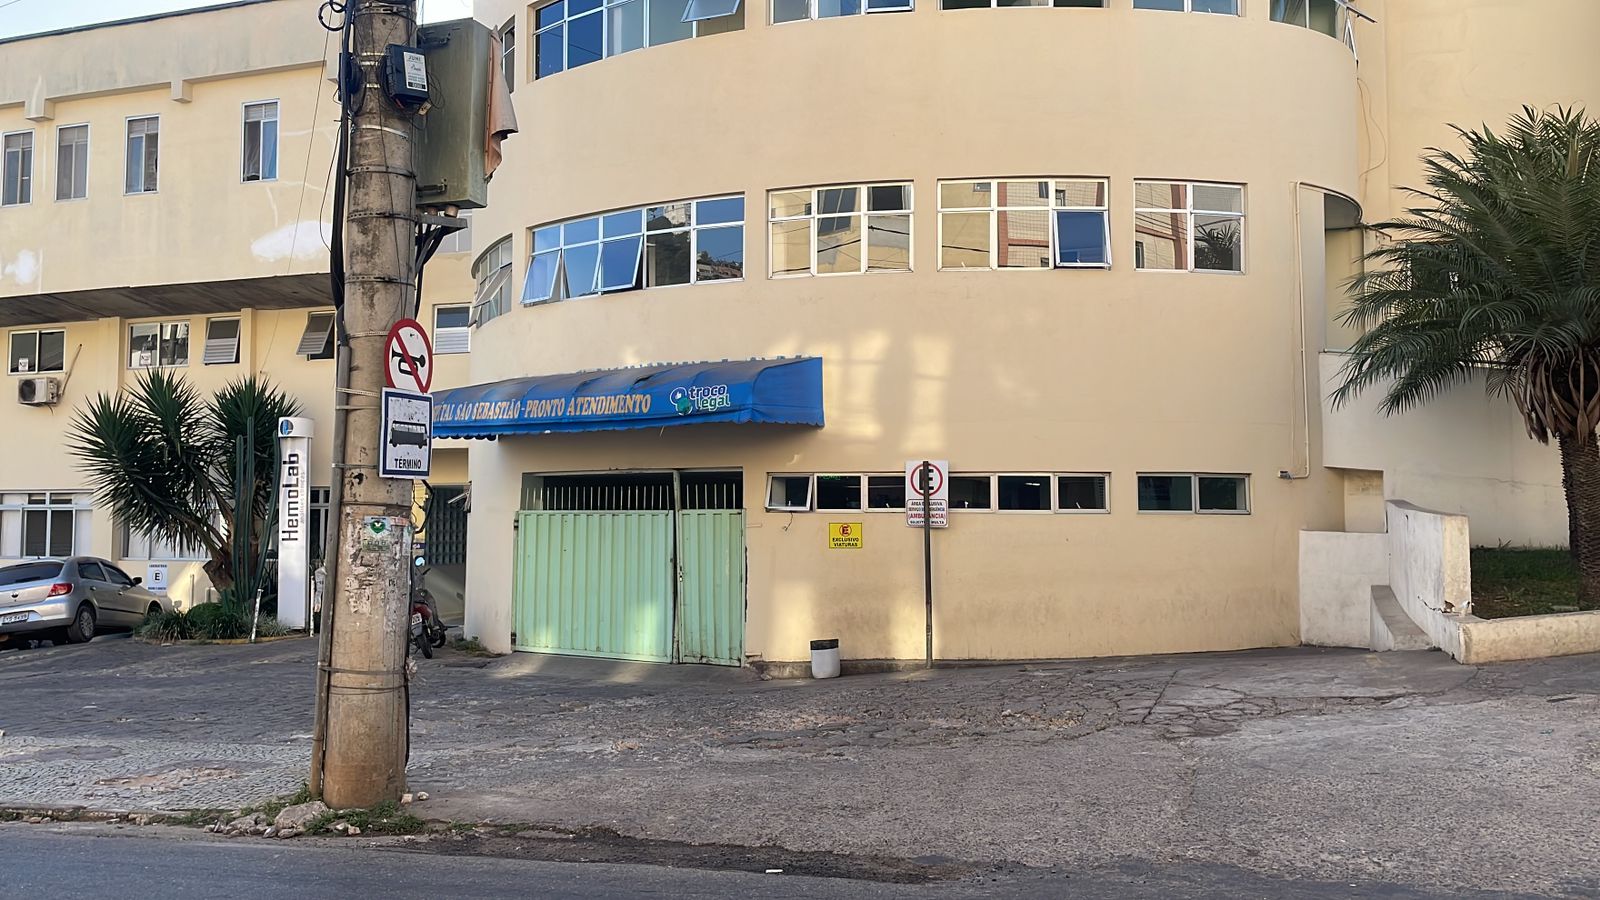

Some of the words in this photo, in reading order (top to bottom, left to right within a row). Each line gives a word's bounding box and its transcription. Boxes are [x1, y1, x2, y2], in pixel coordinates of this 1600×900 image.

[688, 385, 727, 399] troco
[455, 401, 473, 420] SÃO
[472, 399, 521, 420] SEBASTIÃO
[524, 398, 566, 418] PRONTO
[566, 394, 652, 416] ATENDIMENTO
[696, 394, 730, 411] legal
[919, 469, 934, 490] E
[281, 453, 299, 541] HemoLab
[842, 526, 849, 534] E
[154, 572, 161, 581] E
